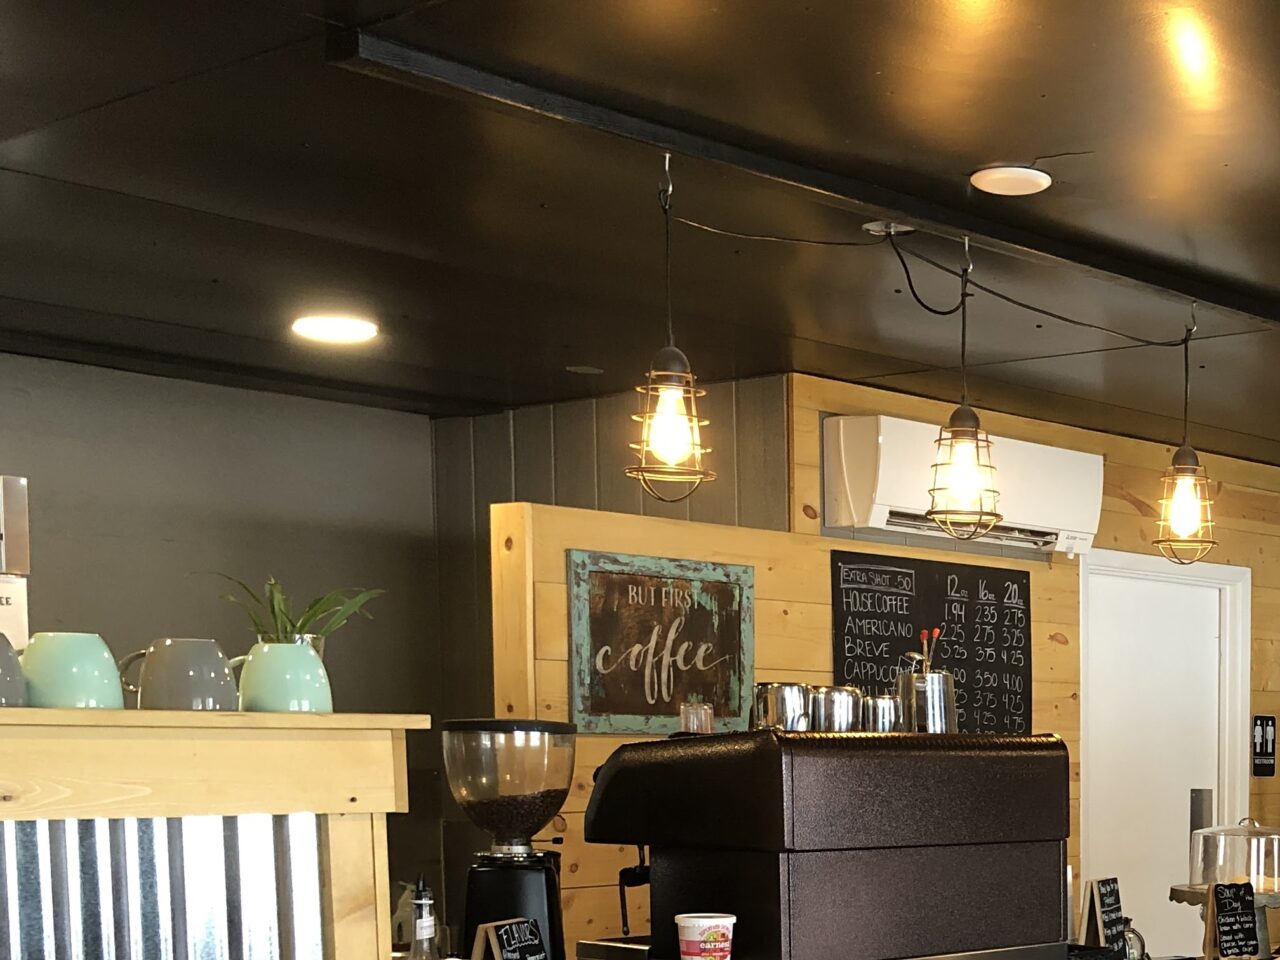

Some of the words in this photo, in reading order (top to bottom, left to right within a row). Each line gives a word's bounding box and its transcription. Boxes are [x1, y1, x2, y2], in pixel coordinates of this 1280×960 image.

[843, 568, 867, 582] EXTRA
[868, 571, 891, 586] SHOT
[628, 585, 656, 607] BUT
[661, 587, 699, 611] FIRST
[844, 615, 913, 638] AMERICANO
[844, 635, 890, 657] BREVE
[595, 615, 732, 704] coffee
